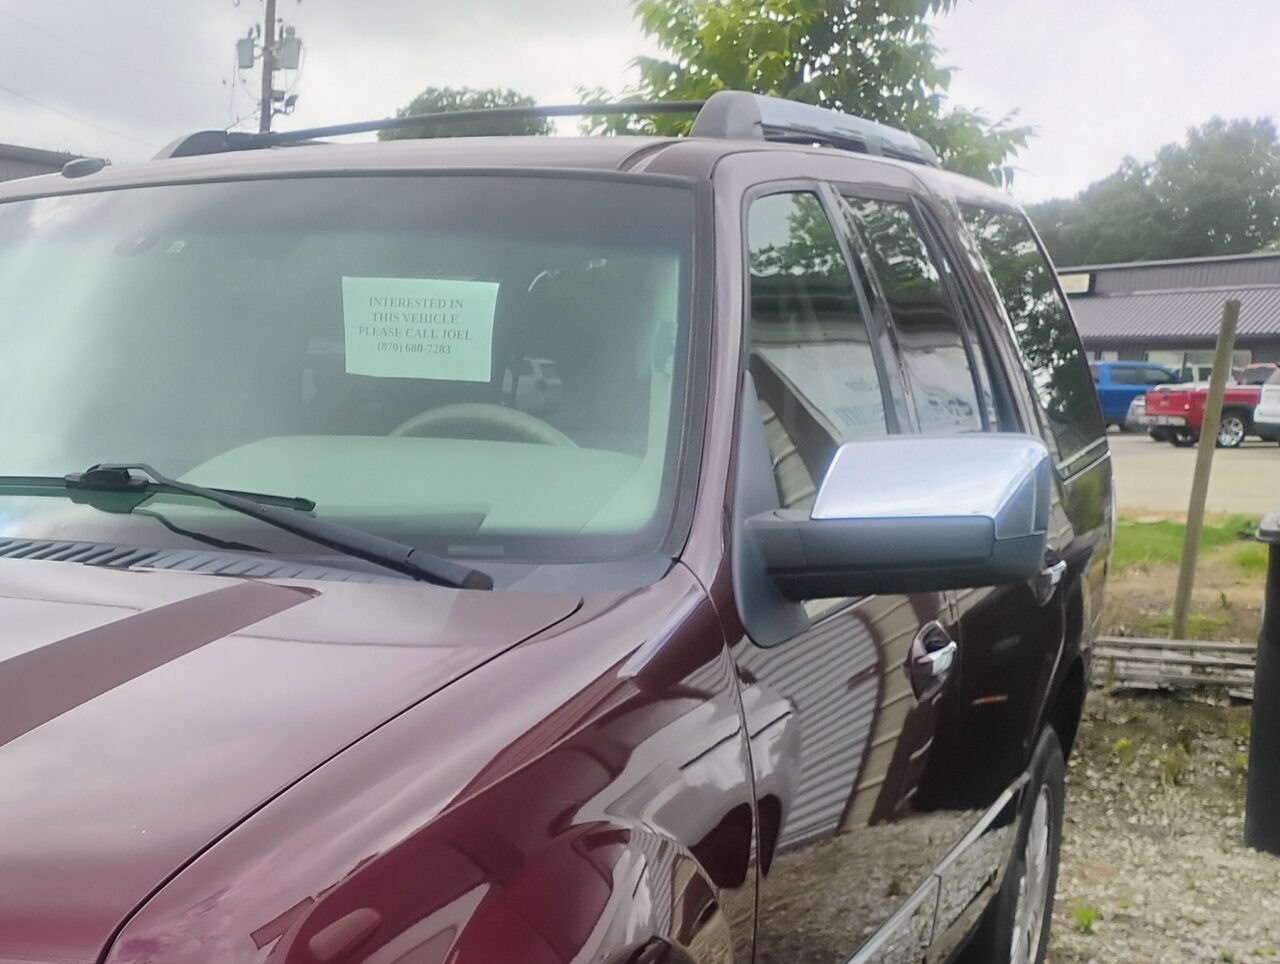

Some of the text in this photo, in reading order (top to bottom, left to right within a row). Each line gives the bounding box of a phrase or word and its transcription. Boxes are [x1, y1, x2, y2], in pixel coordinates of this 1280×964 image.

[369, 297, 463, 309] INTERESTED IN
[372, 312, 458, 324] THIS VEHICLE
[358, 326, 472, 341] PLEASE CALL JOEL
[377, 342, 403, 354] (870)
